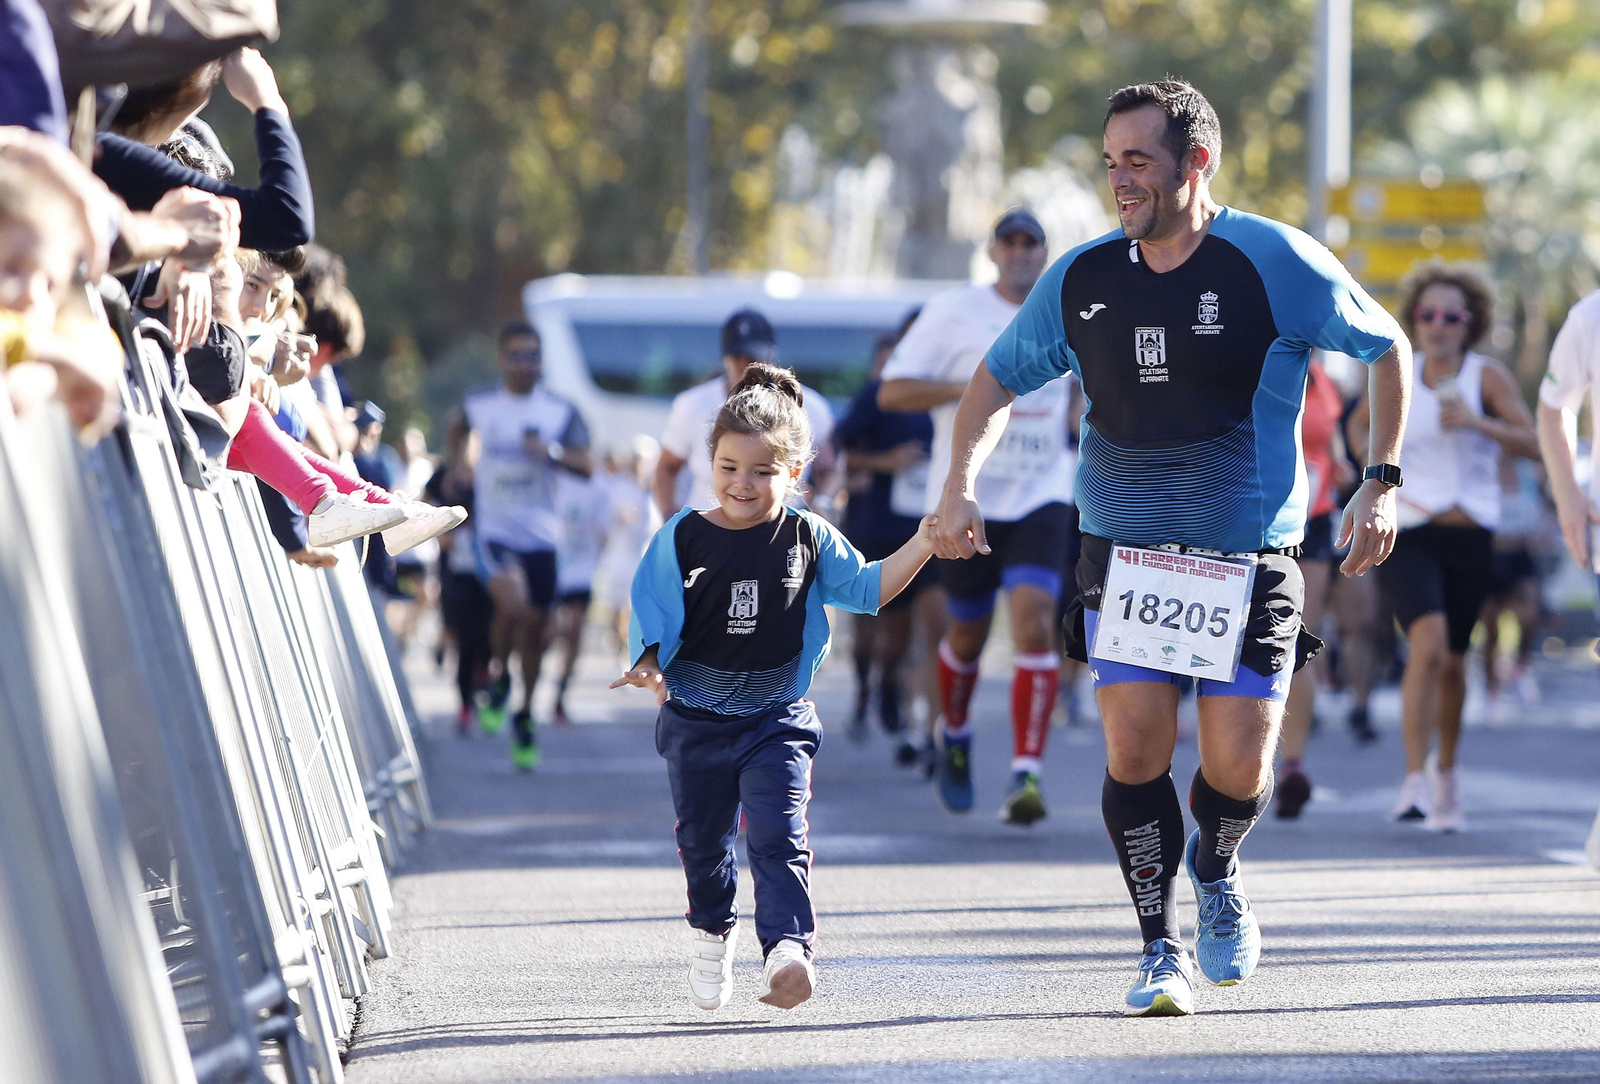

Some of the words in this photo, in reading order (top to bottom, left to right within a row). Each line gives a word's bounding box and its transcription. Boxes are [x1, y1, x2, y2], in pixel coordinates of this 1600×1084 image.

[1140, 375, 1169, 383] ALFARNATE
[1118, 549, 1139, 566] 41
[1142, 552, 1196, 568] CARRERA
[1198, 560, 1246, 578] URBANA
[1142, 560, 1174, 572] CIUDAD
[1176, 566, 1187, 574] DE
[1189, 568, 1226, 581] MALAGA
[1118, 589, 1231, 638] 18205
